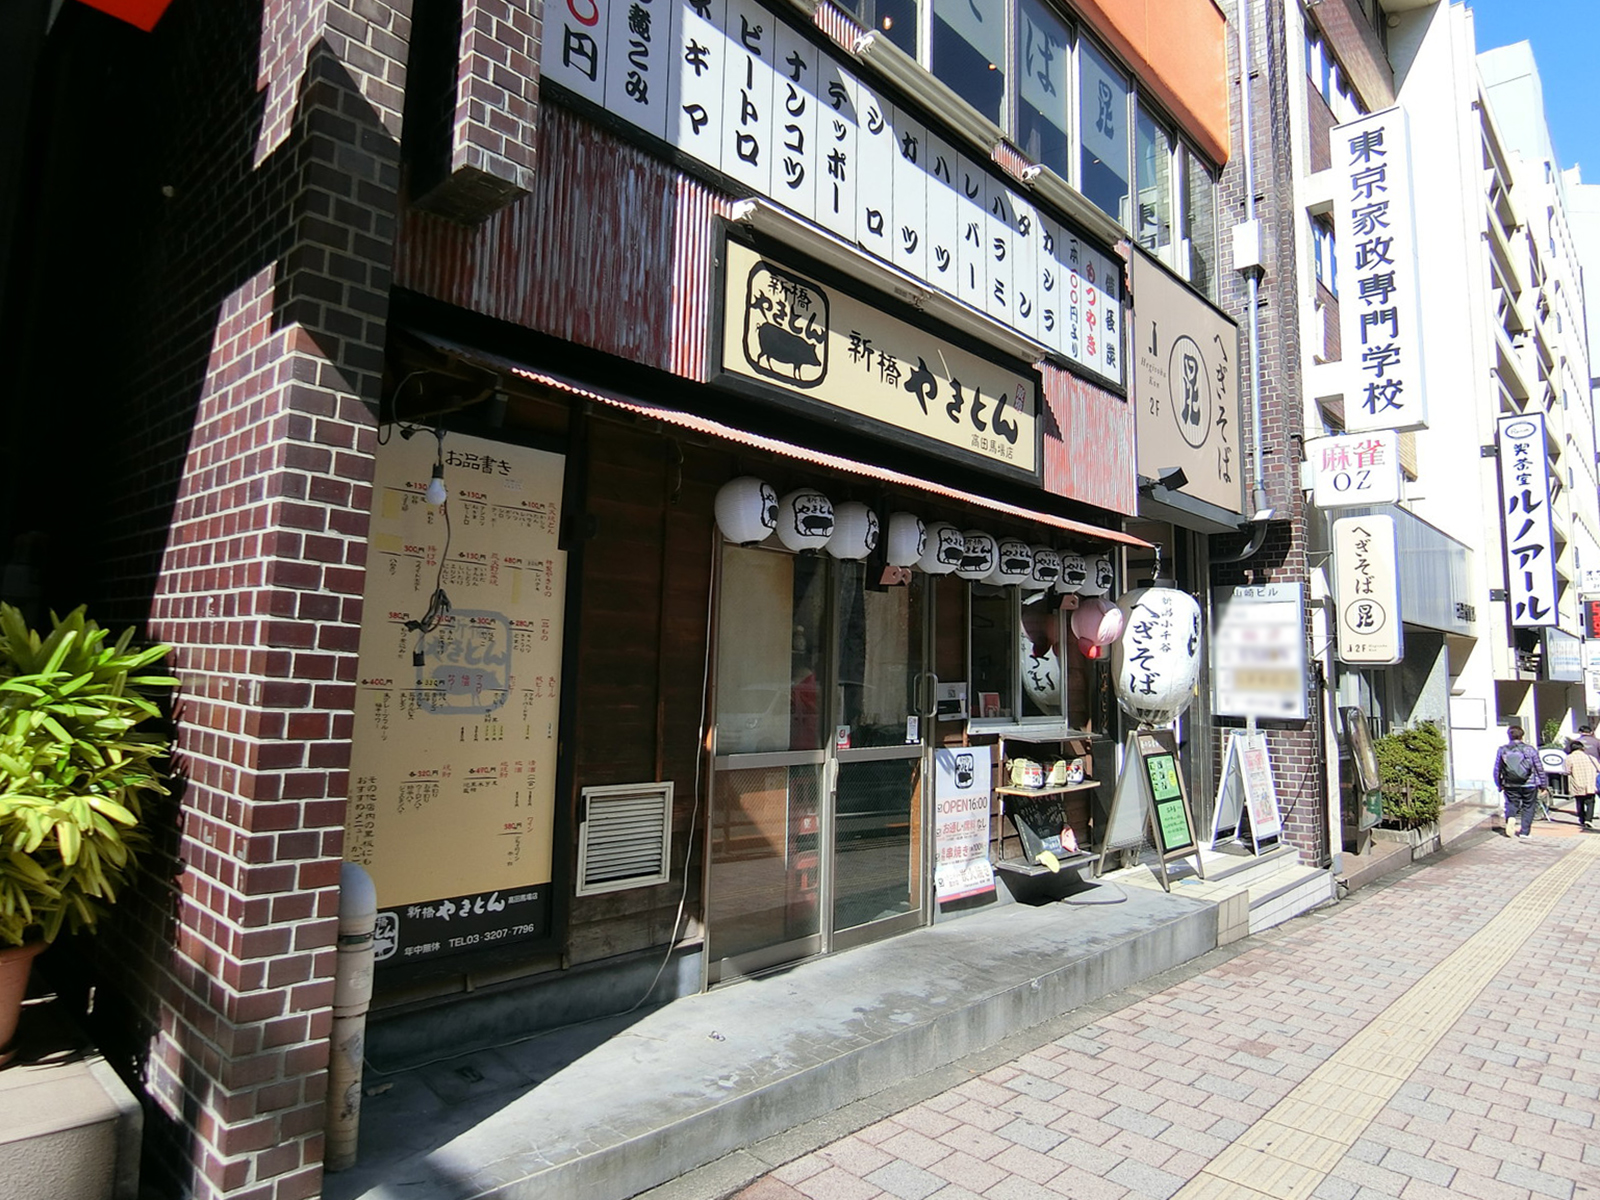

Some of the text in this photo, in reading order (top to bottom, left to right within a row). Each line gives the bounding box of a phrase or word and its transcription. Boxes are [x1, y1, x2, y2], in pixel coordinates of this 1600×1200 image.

[827, 80, 848, 214] テッポー
[1348, 126, 1404, 415] 東京家政専門学校
[750, 289, 826, 345] やきとん
[445, 450, 512, 476] お品書き
[1321, 439, 1386, 472] 麻雀
[1351, 526, 1376, 595] へぎそば
[1508, 489, 1551, 621] ルノアール
[1130, 603, 1161, 696] へぎそば
[943, 799, 968, 814] OPEN
